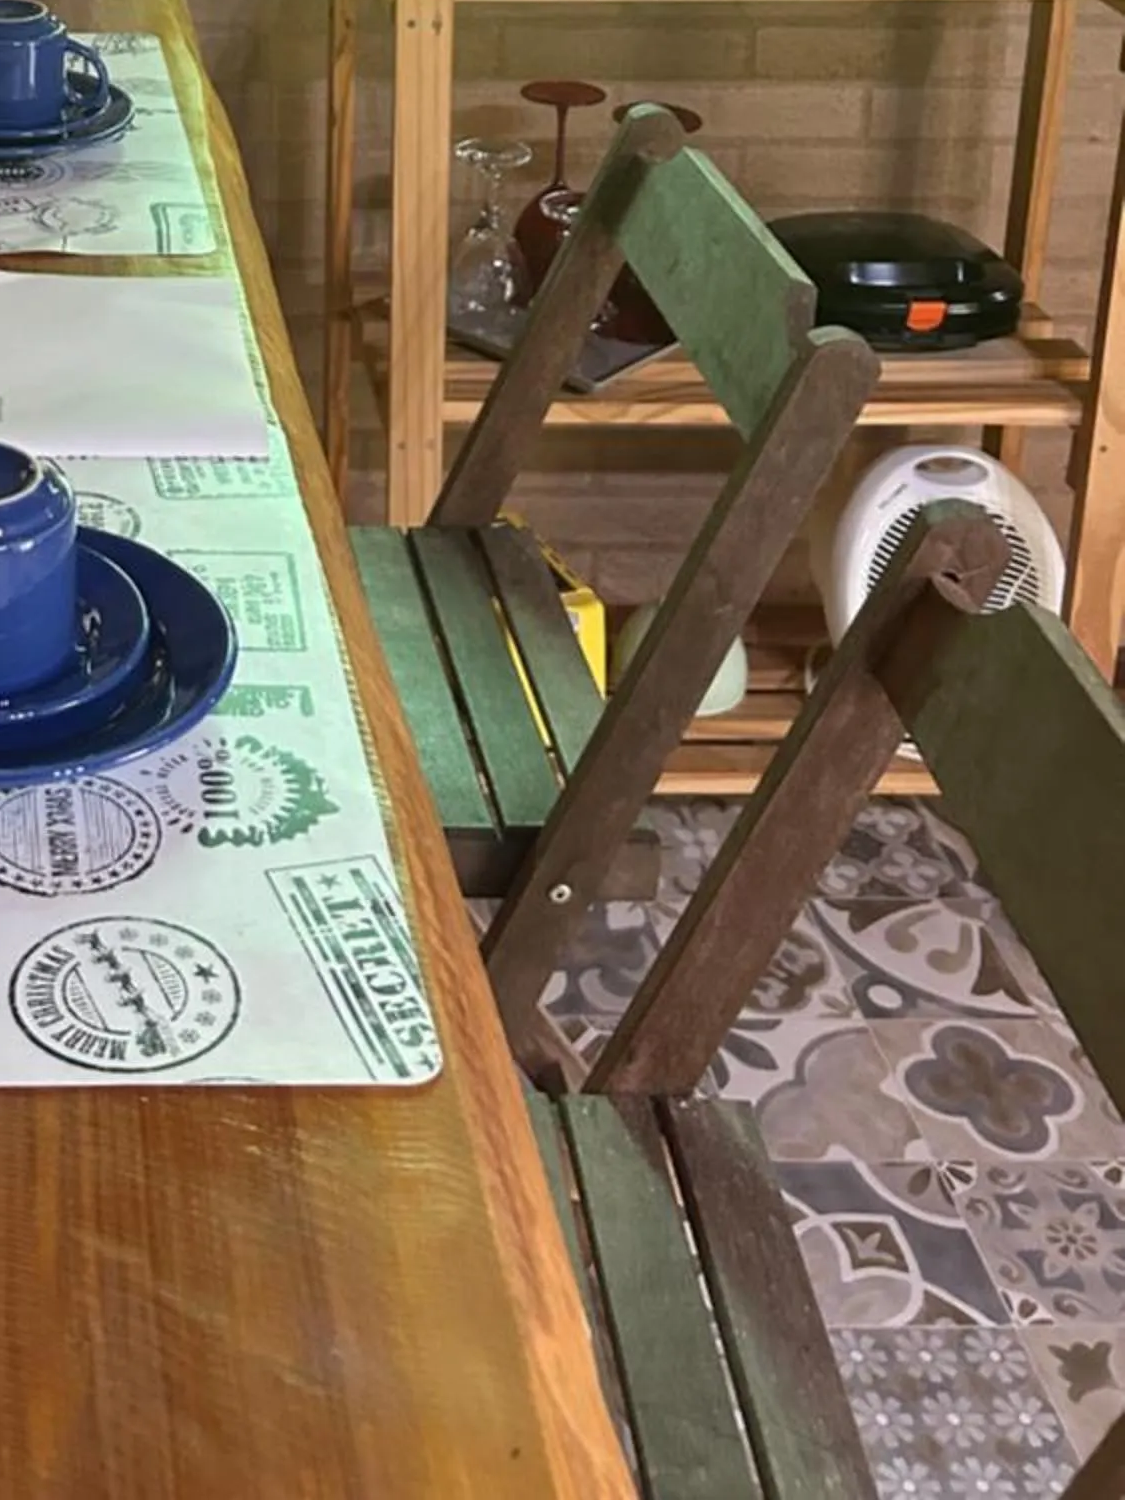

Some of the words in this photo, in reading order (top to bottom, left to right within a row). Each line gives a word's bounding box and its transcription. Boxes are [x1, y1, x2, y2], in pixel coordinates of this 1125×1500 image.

[44, 787, 76, 828] XMAS
[198, 746, 240, 819] 100%
[47, 829, 79, 877] MERRY
[25, 943, 77, 1029] CHRISTMAS
[322, 895, 439, 1048] SECRET
[51, 1026, 129, 1062] MERRY
